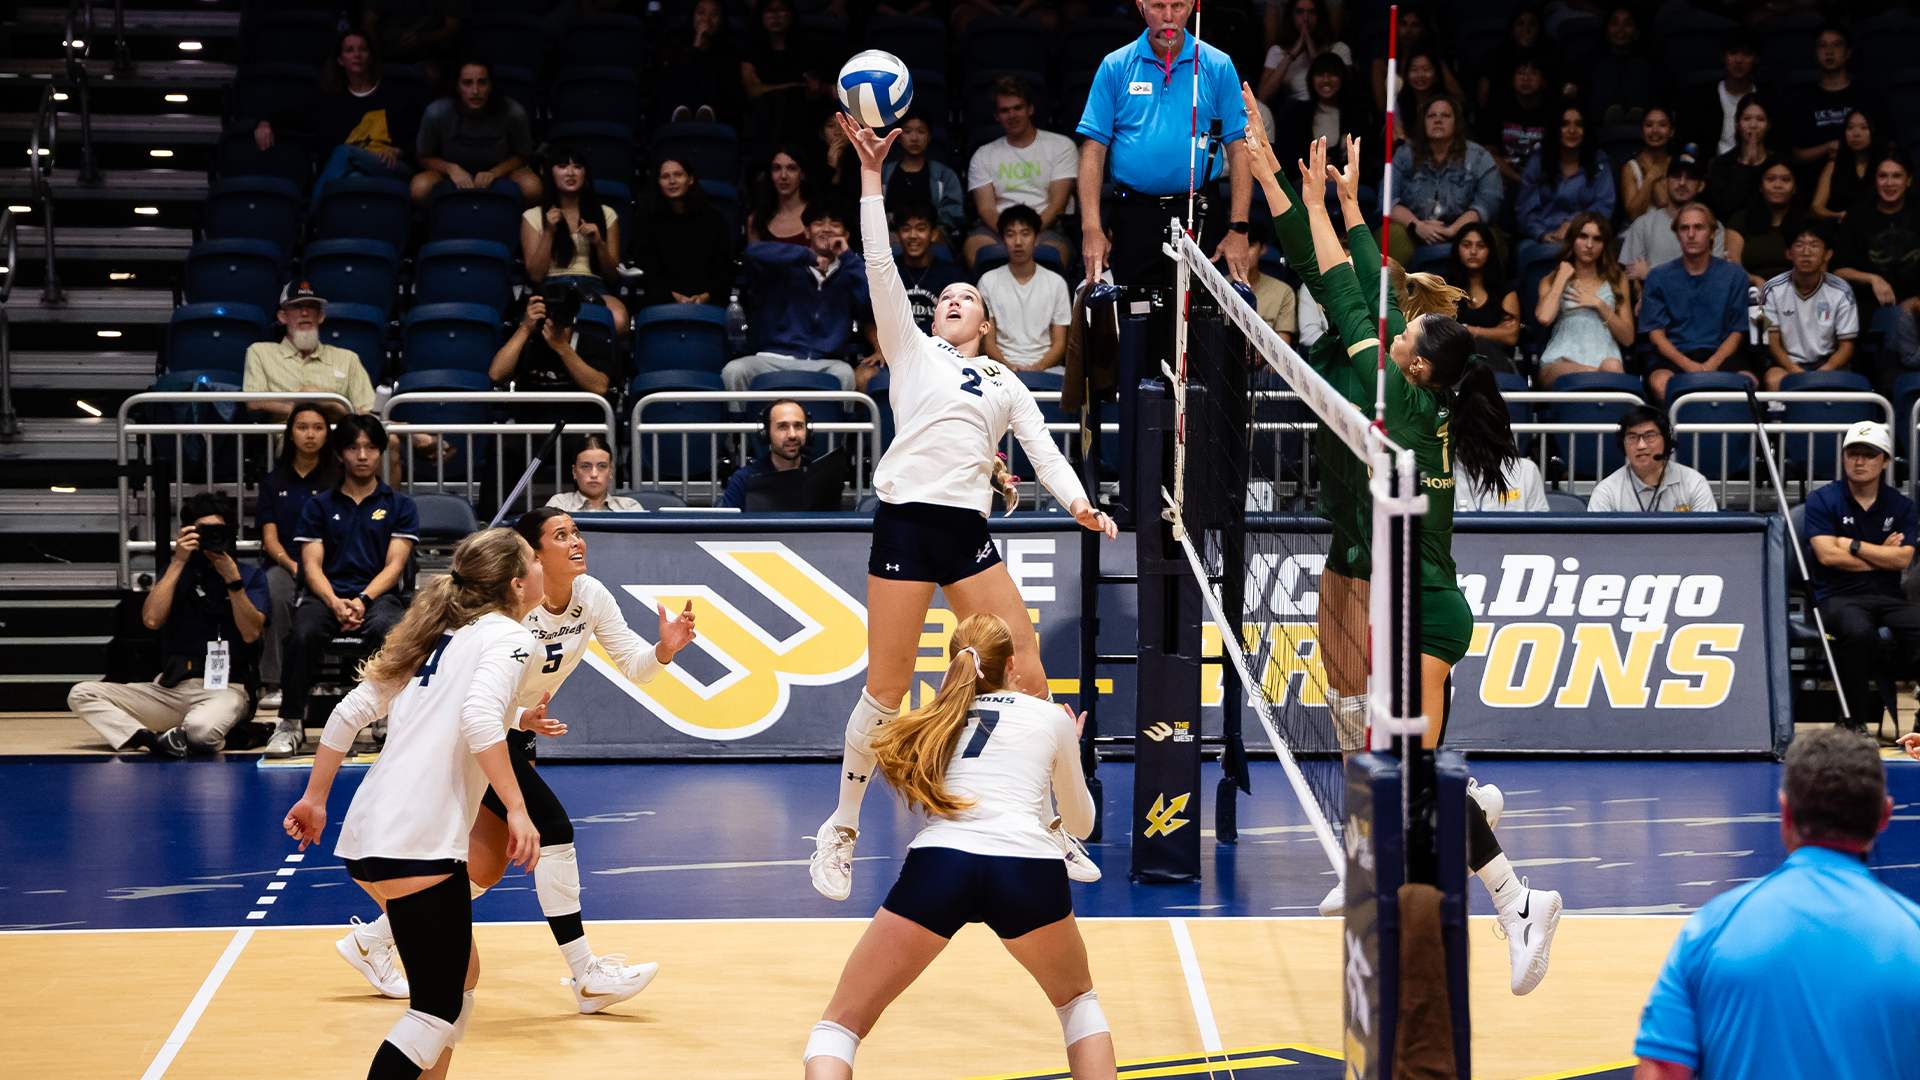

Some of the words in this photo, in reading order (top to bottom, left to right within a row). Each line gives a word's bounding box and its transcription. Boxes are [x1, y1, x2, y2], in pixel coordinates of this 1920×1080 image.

[960, 368, 983, 397] 2
[542, 642, 564, 674] 5
[961, 709, 1000, 759] 7
[1173, 721, 1190, 729] THE
[1173, 728, 1189, 736] BIG
[1173, 734, 1195, 742] WEST
